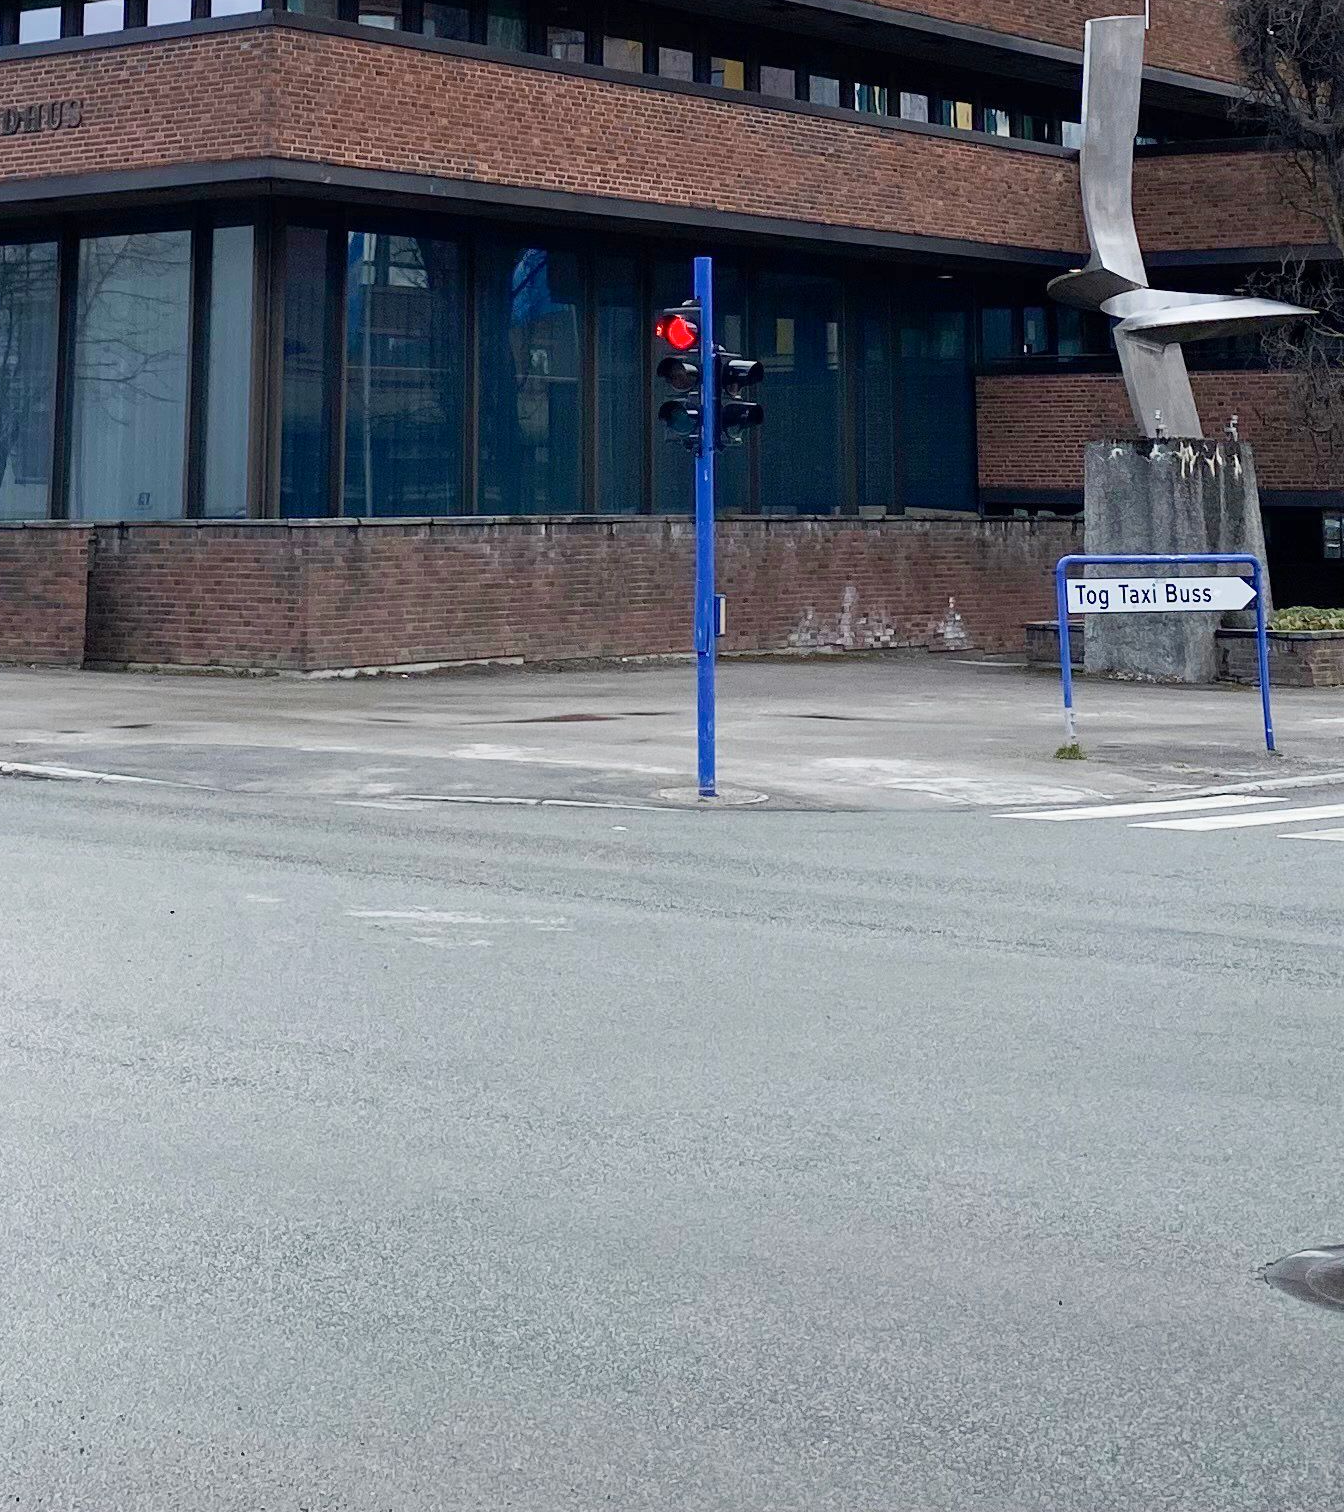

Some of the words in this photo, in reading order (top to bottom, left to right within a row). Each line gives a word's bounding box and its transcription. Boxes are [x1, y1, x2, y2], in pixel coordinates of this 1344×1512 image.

[1075, 584, 1109, 609] Tog
[1118, 583, 1157, 604] Taxi
[1165, 583, 1212, 603] Buss
